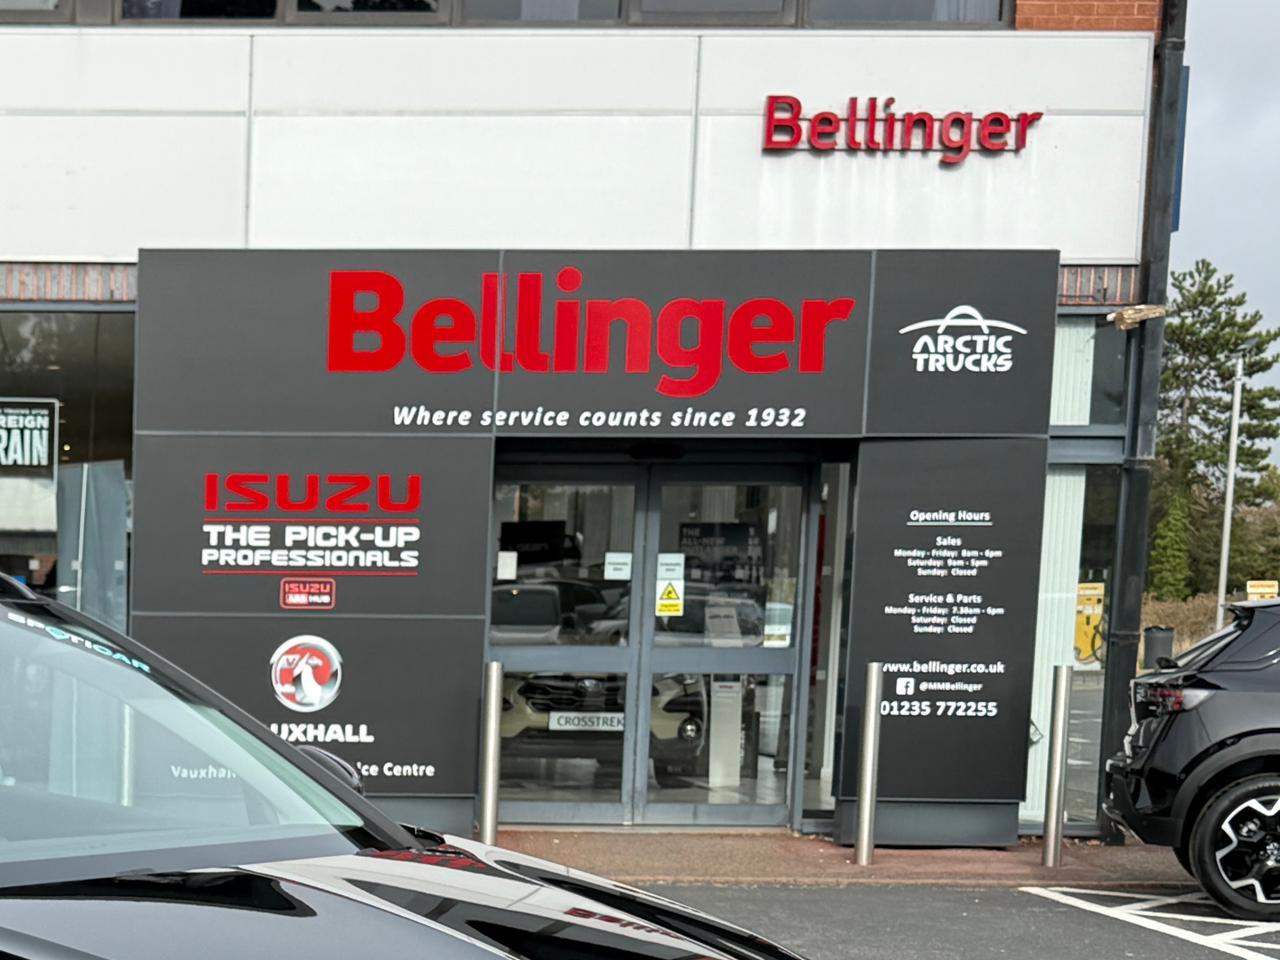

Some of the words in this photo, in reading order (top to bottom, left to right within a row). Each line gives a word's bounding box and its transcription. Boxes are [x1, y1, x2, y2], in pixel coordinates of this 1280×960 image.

[763, 95, 1044, 164] Bellinger
[326, 266, 856, 398] Bellinger
[913, 335, 1013, 353] ARCTIC
[912, 353, 1013, 372] TRUCKS
[392, 406, 472, 426] Where
[480, 406, 570, 427] service
[578, 407, 662, 427] counts
[671, 406, 735, 428] since
[745, 407, 807, 428] 1932
[204, 473, 422, 512] ISUZU
[909, 510, 956, 522] Opening
[957, 510, 991, 521] Hours
[202, 525, 271, 546] THE
[285, 525, 421, 548] PICK-UP
[935, 536, 962, 546] Sales
[201, 548, 419, 568] PROFESSIONALS
[893, 548, 926, 558] Monday
[907, 558, 944, 568] Saturday:
[917, 568, 948, 577] Sunday:
[950, 568, 978, 576] Closed
[285, 583, 330, 593] ISUZU
[908, 593, 944, 603] Service
[945, 593, 955, 603] &
[956, 593, 982, 603] Parts
[884, 606, 917, 615] Monday
[911, 616, 948, 625] Saturday:
[950, 616, 978, 624] Closed
[913, 625, 944, 634] Sunday:
[947, 625, 975, 634] Closed
[880, 701, 931, 716] 01235
[936, 701, 998, 716] 772255
[557, 715, 624, 728] CROSSTREK
[270, 723, 375, 743] UXHALL
[383, 762, 436, 776] Centre
